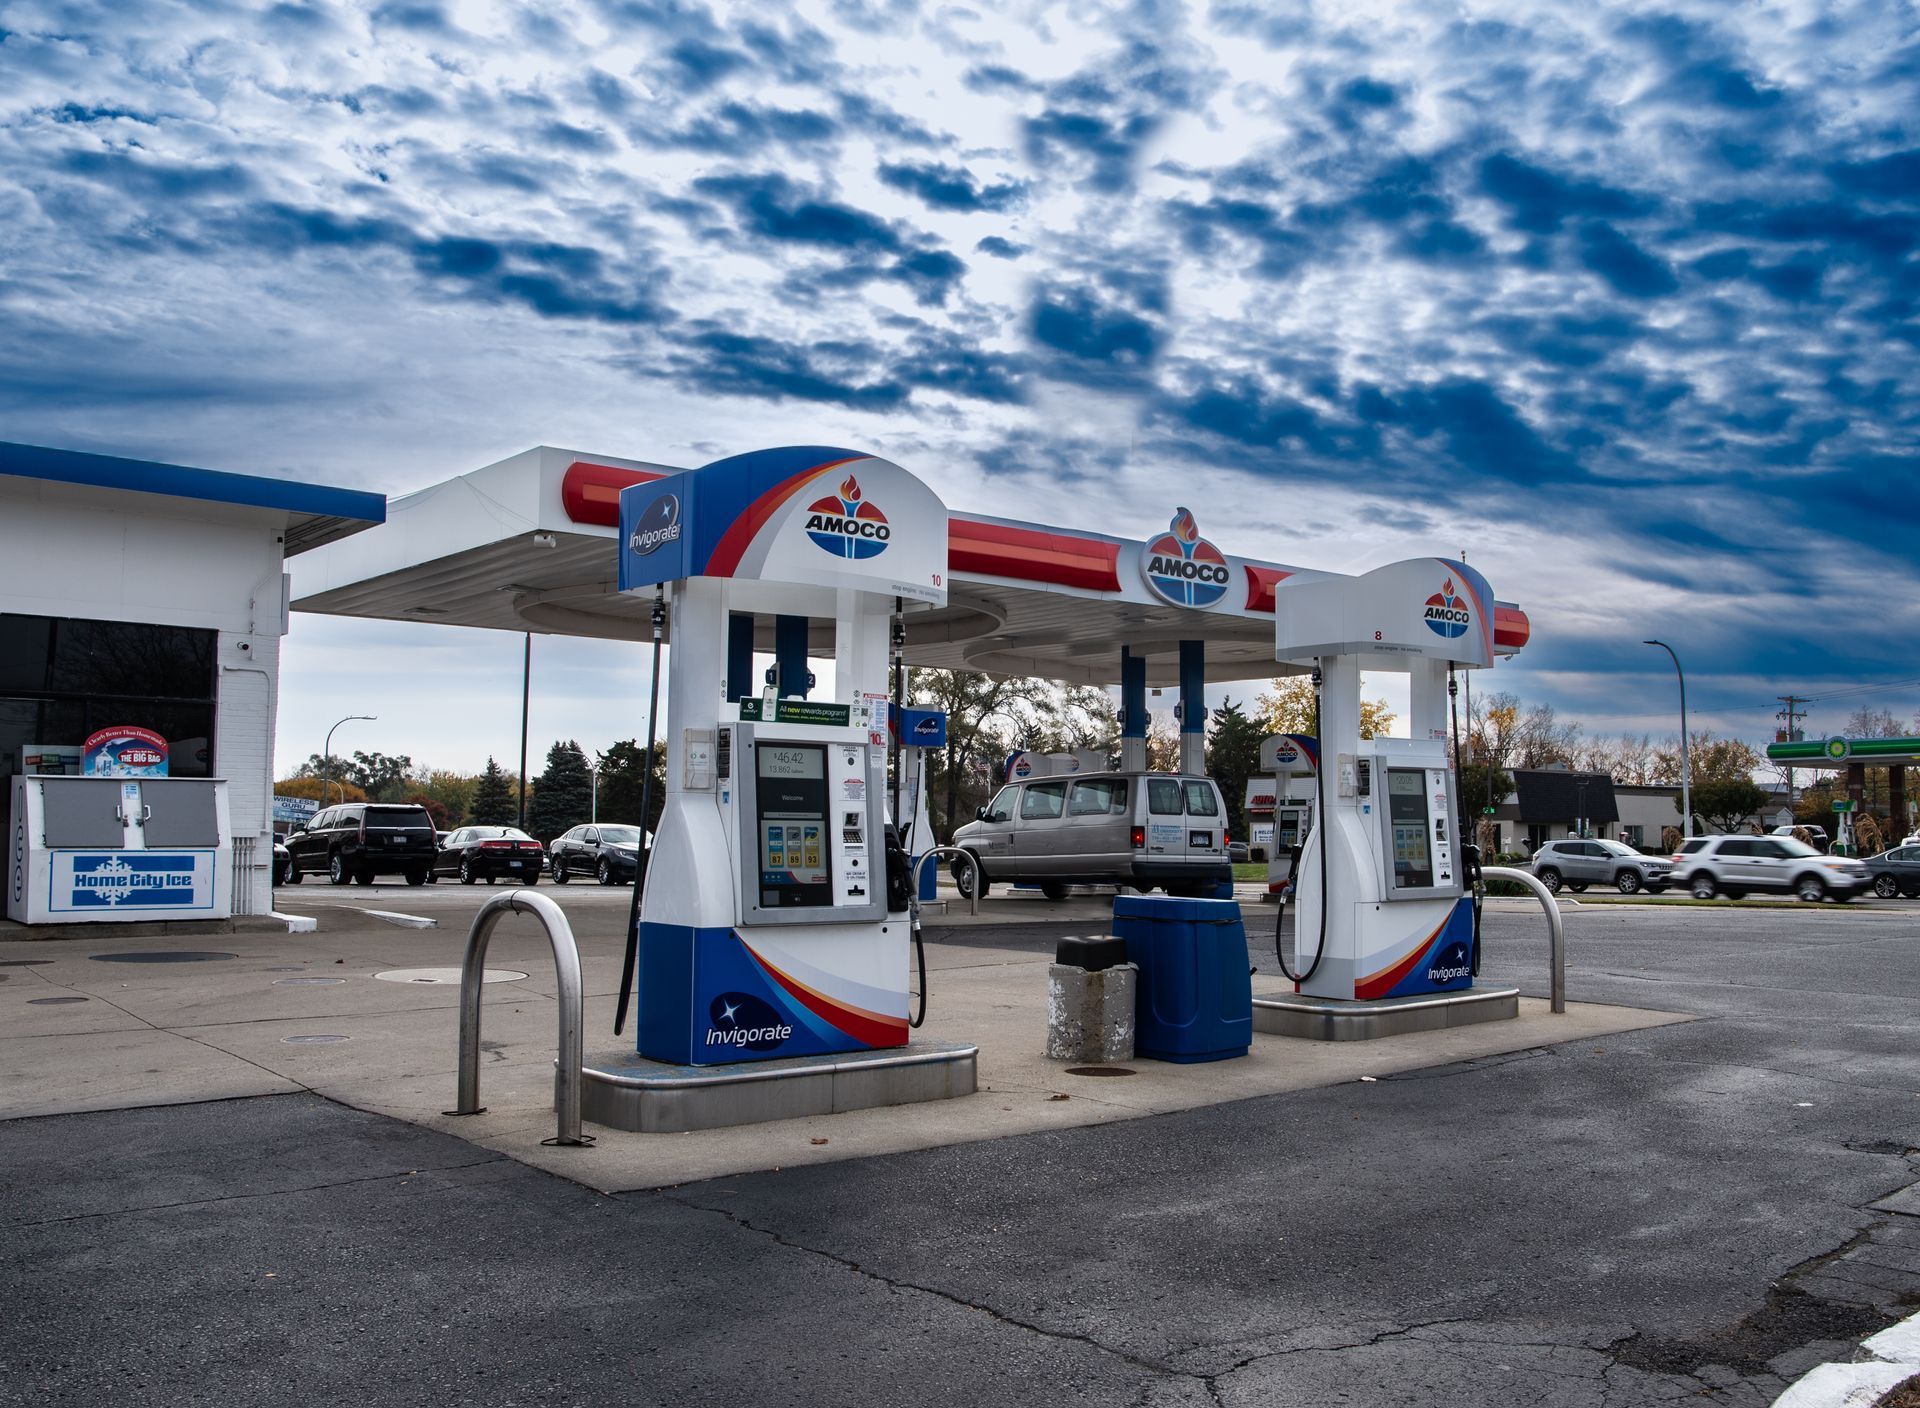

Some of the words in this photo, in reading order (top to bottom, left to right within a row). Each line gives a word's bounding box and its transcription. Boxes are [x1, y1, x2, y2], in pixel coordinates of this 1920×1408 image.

[805, 515, 890, 541] AMOCO
[629, 524, 679, 549] Invigorate
[1147, 556, 1229, 584] AMOCO
[931, 573, 942, 587] 10
[1424, 607, 1470, 624] AMOCO
[1375, 630, 1382, 641] 8
[808, 675, 814, 685] 2
[779, 705, 787, 713] All
[800, 707, 822, 716] rewards
[821, 708, 847, 718] program!
[914, 725, 940, 735] Invigorate
[870, 732, 881, 745] 10
[120, 754, 132, 762] THE
[133, 753, 147, 763] BIG
[147, 754, 161, 763] BAG
[774, 752, 804, 764] $46.42
[273, 796, 316, 806] WIRELESS
[281, 802, 306, 810] GURU
[772, 855, 781, 864] 87
[790, 855, 800, 864] 89
[807, 855, 817, 864] 93
[74, 874, 127, 887] Home
[129, 874, 163, 889] City
[166, 873, 192, 886] Ice
[1428, 966, 1470, 982] Invigorate
[706, 1024, 792, 1047] Invigorate
